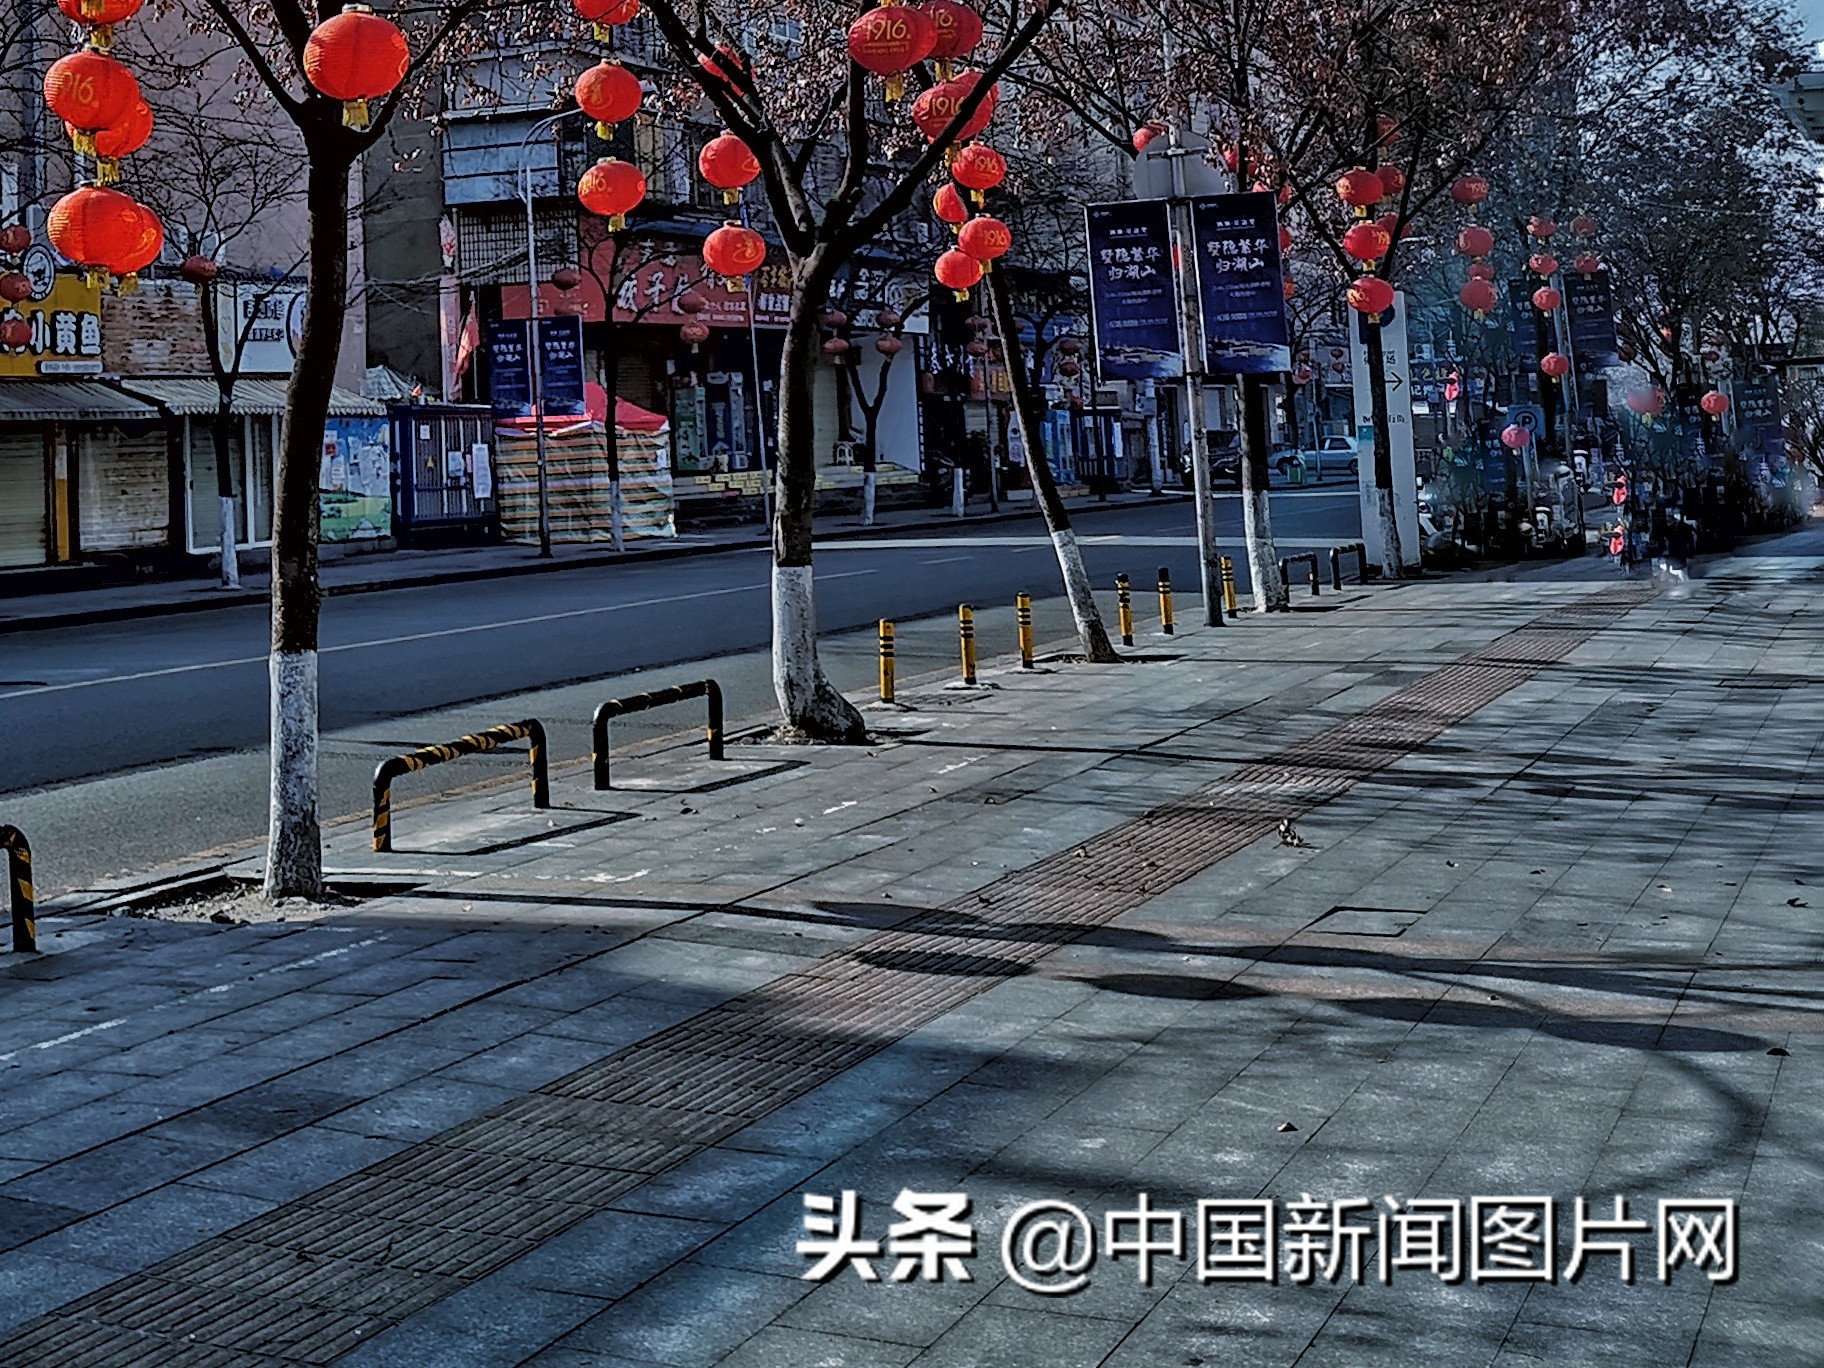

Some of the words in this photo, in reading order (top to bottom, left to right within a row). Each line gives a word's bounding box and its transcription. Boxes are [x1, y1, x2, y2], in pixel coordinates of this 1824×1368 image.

[1108, 263, 1157, 282] 归湖山
[1215, 256, 1265, 274] 归湖山
